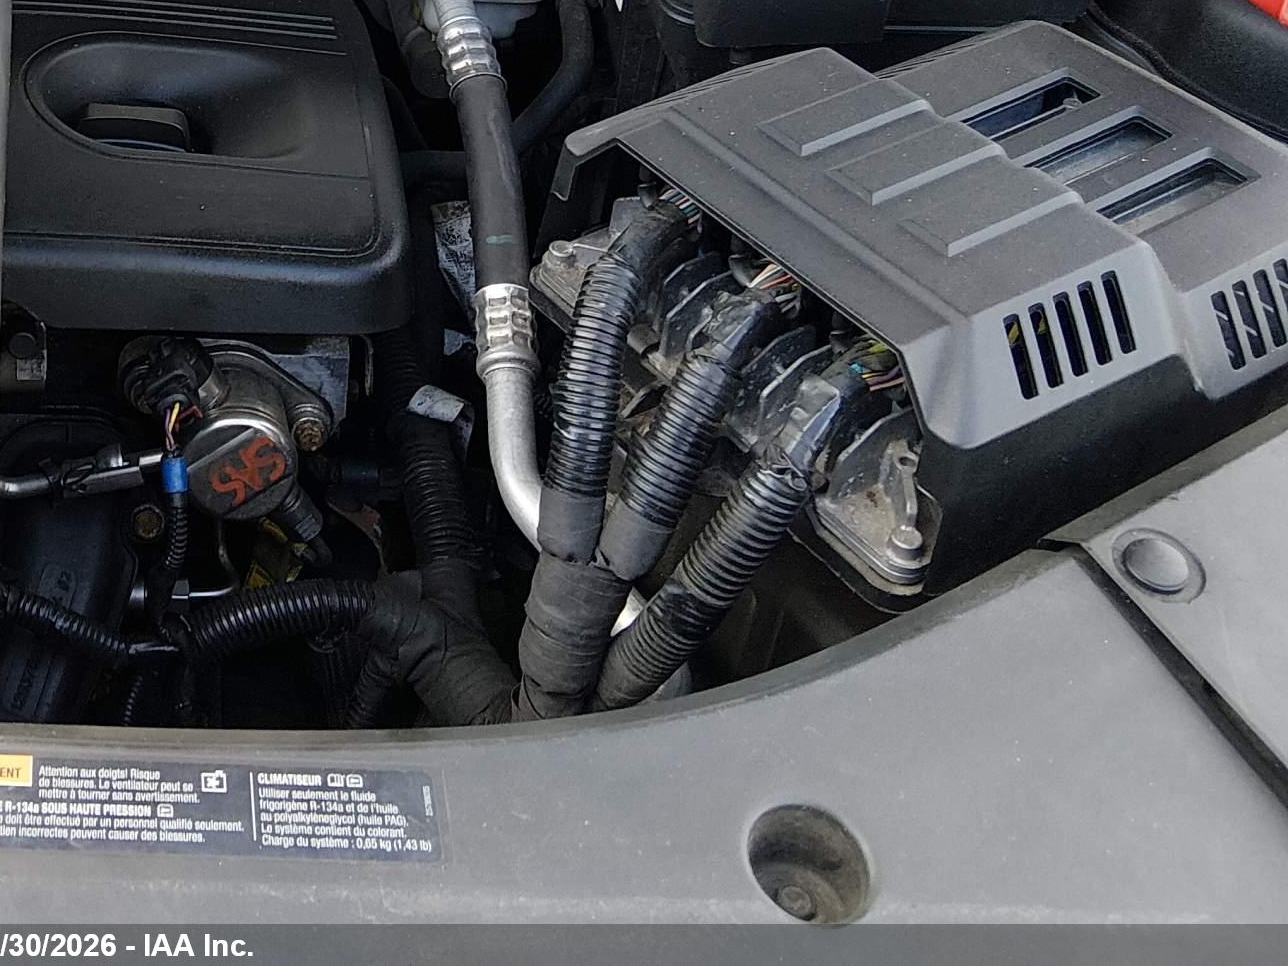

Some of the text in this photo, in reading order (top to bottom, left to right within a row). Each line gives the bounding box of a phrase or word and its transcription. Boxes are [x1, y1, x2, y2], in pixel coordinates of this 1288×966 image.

[38, 765, 79, 777] Attention
[80, 769, 96, 778] aux
[130, 768, 160, 781] Risque
[257, 772, 322, 786] CLIMATISEUR
[38, 788, 67, 799] mettre
[77, 789, 110, 800] tourner
[112, 792, 133, 801] sans
[135, 791, 200, 803] avertissement.
[259, 787, 376, 802] Utiliser seulement le fluide
[5, 800, 39, 813] R-134a
[41, 802, 68, 814] SOUS
[69, 802, 101, 815] HAUTE
[103, 803, 152, 817] PRESSION
